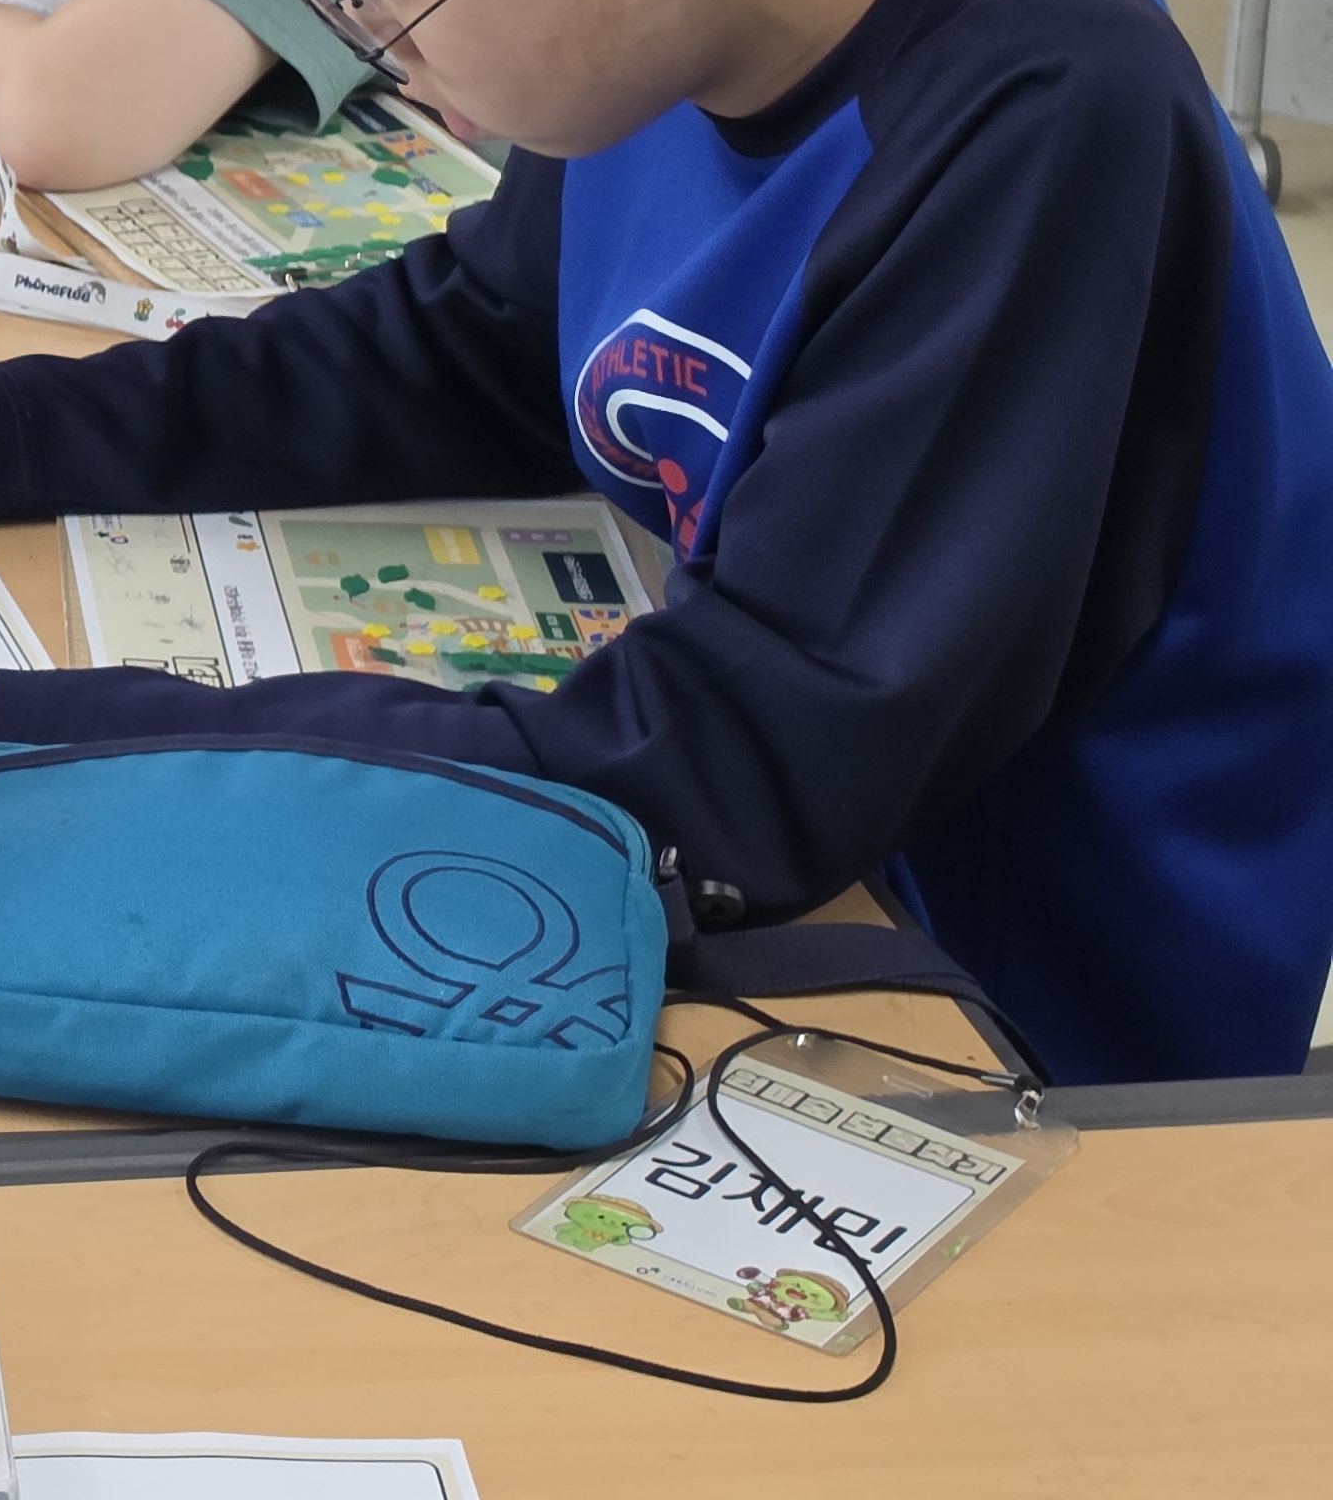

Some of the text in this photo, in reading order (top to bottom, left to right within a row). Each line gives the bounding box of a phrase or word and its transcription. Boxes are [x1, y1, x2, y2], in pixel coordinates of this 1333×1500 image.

[591, 338, 708, 398] ATHLETIC
[720, 1067, 1010, 1185] 원미숲 보물찾기
